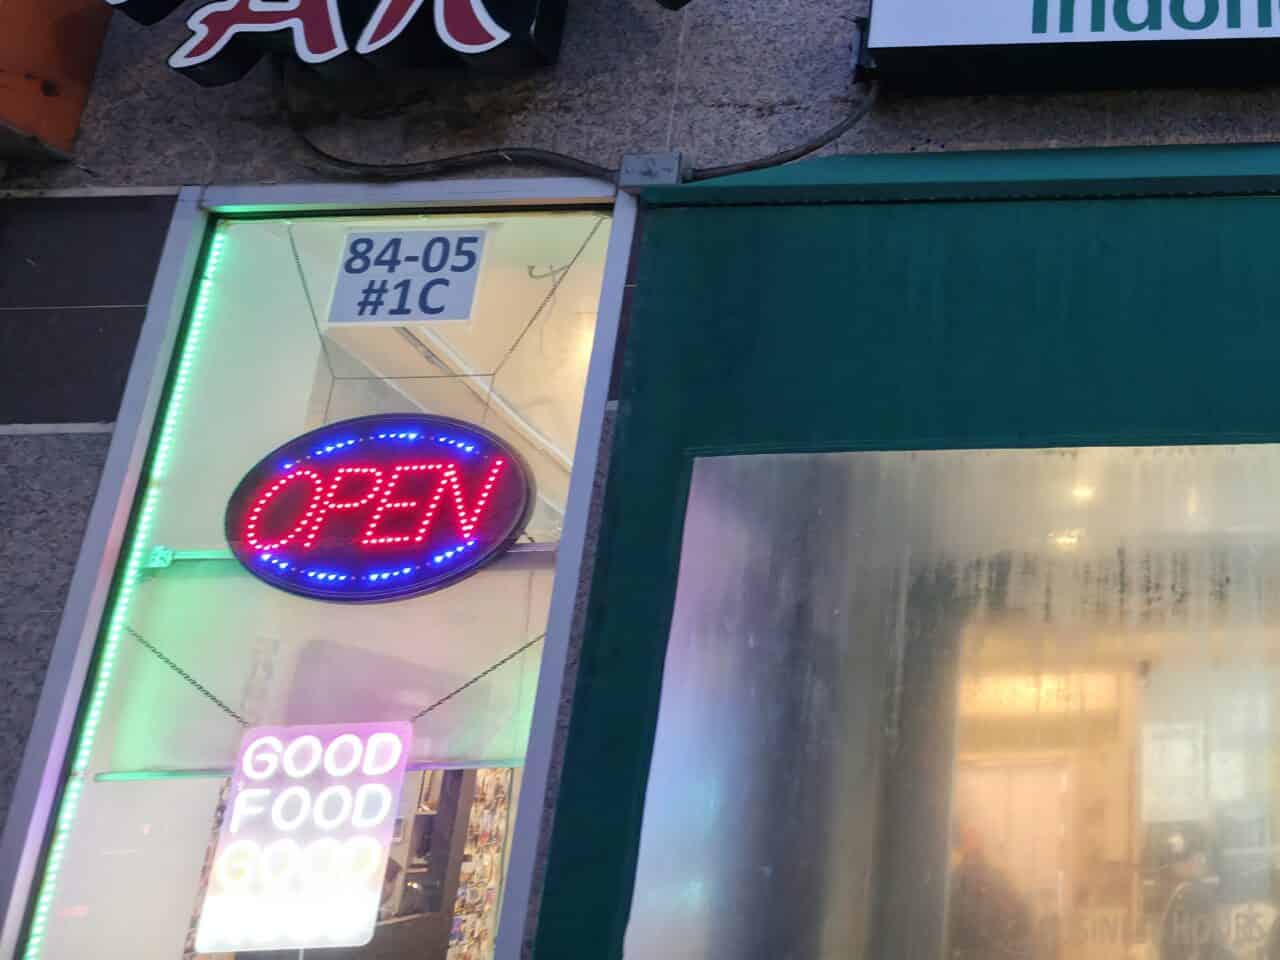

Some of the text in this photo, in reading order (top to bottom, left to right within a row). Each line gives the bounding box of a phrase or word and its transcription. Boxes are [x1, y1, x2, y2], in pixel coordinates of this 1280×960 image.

[344, 236, 479, 275] 84-05
[357, 278, 450, 317] #1C
[245, 456, 505, 552] OPEN
[242, 731, 403, 781] GOOD
[229, 783, 393, 833] FOOD
